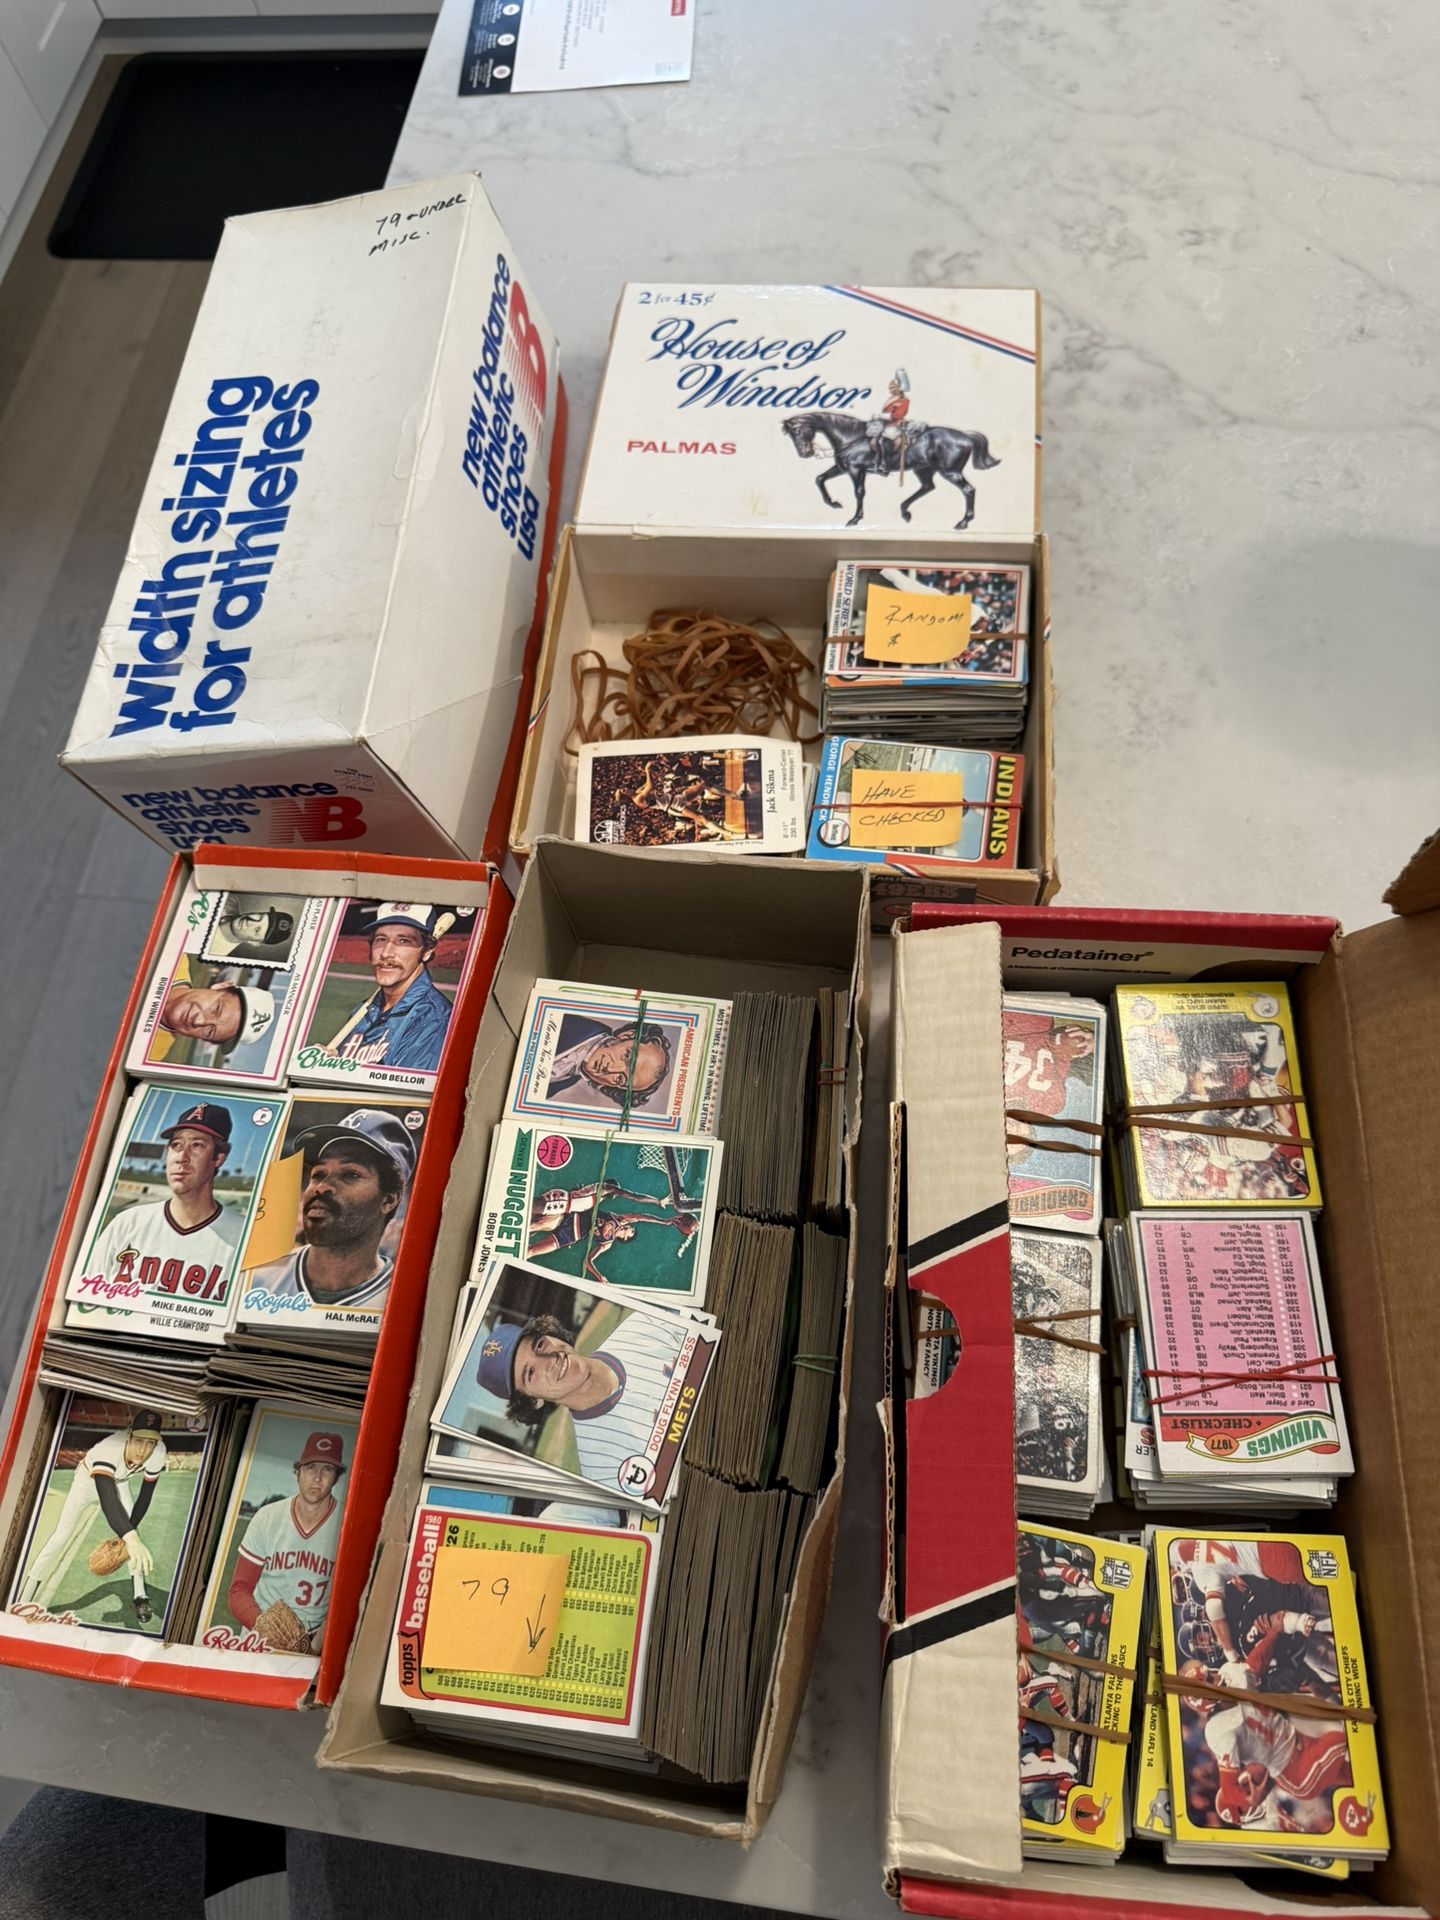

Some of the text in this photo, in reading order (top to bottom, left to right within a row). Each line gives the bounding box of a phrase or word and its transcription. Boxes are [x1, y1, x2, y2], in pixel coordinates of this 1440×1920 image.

[638, 292, 652, 305] 2
[655, 294, 672, 305] for
[647, 317, 846, 370] House of
[461, 253, 510, 489] new balance
[677, 363, 871, 410] Windsor
[482, 373, 514, 512] athletic
[627, 440, 737, 455] PALMAS
[500, 424, 527, 538] shoes
[517, 485, 541, 561] usa
[110, 375, 273, 738] width sizing
[170, 378, 320, 733] for athletes
[840, 564, 855, 628] WORLD SERIES
[766, 770, 777, 813] Jack Sikma
[819, 736, 839, 821] GEORGE HENDRCK
[861, 780, 916, 804] HAVE
[120, 788, 196, 808] new
[198, 781, 339, 800] balance
[986, 756, 1017, 860] INDIANS
[141, 802, 261, 822] athletic
[156, 816, 252, 836] shoes
[309, 908, 320, 930] PLAYER
[143, 977, 168, 1033] BOBBY WINKLES
[283, 983, 298, 1015] MANAGER
[716, 1008, 725, 1025] MOST
[297, 1046, 361, 1072] Braves
[671, 1026, 696, 1117] AMERICAN PRESIDENTS
[369, 1071, 425, 1085] ROB BELLOIR
[699, 1103, 709, 1132] LIFETIME
[549, 1139, 559, 1164] FORWARD
[494, 1137, 528, 1258] DENVER NUGGET
[484, 1212, 498, 1241] BOBBY
[78, 1273, 145, 1299] Angels
[244, 1288, 313, 1313] Royals
[152, 1300, 214, 1317] MIKE BARLOW
[325, 1311, 380, 1325] HAL McRAE
[150, 1317, 209, 1332] WILLIE CRAWFORD
[923, 1349, 931, 1377] FANCY
[931, 1353, 940, 1387] VIKINGS
[649, 1335, 696, 1453] DOUG FLYNN 2B-SS
[667, 1386, 696, 1444] METS
[1170, 1417, 1252, 1429] CHECKLIST
[1209, 1419, 1329, 1456] VIKINGS 1977
[423, 1514, 442, 1524] 1980
[444, 1524, 460, 1548] 26
[263, 1551, 335, 1576] CINCINNAT
[405, 1524, 440, 1629] baseball
[1320, 1552, 1337, 1577] NFL
[295, 1580, 329, 1606] 37
[462, 1577, 510, 1606] 79
[202, 1626, 275, 1653] Reds
[401, 1642, 415, 1687] topps
[1118, 1644, 1126, 1667] ASICS
[1103, 1653, 1118, 1731] ATLANTA FALNS
[1342, 1646, 1359, 1733] KAAS CITY CHIEFS
[1351, 1658, 1362, 1709] NNING WIDE
[1114, 1693, 1121, 1704] TO
[1111, 1707, 1120, 1744] SCKING
[1147, 1757, 1154, 1767] 14
